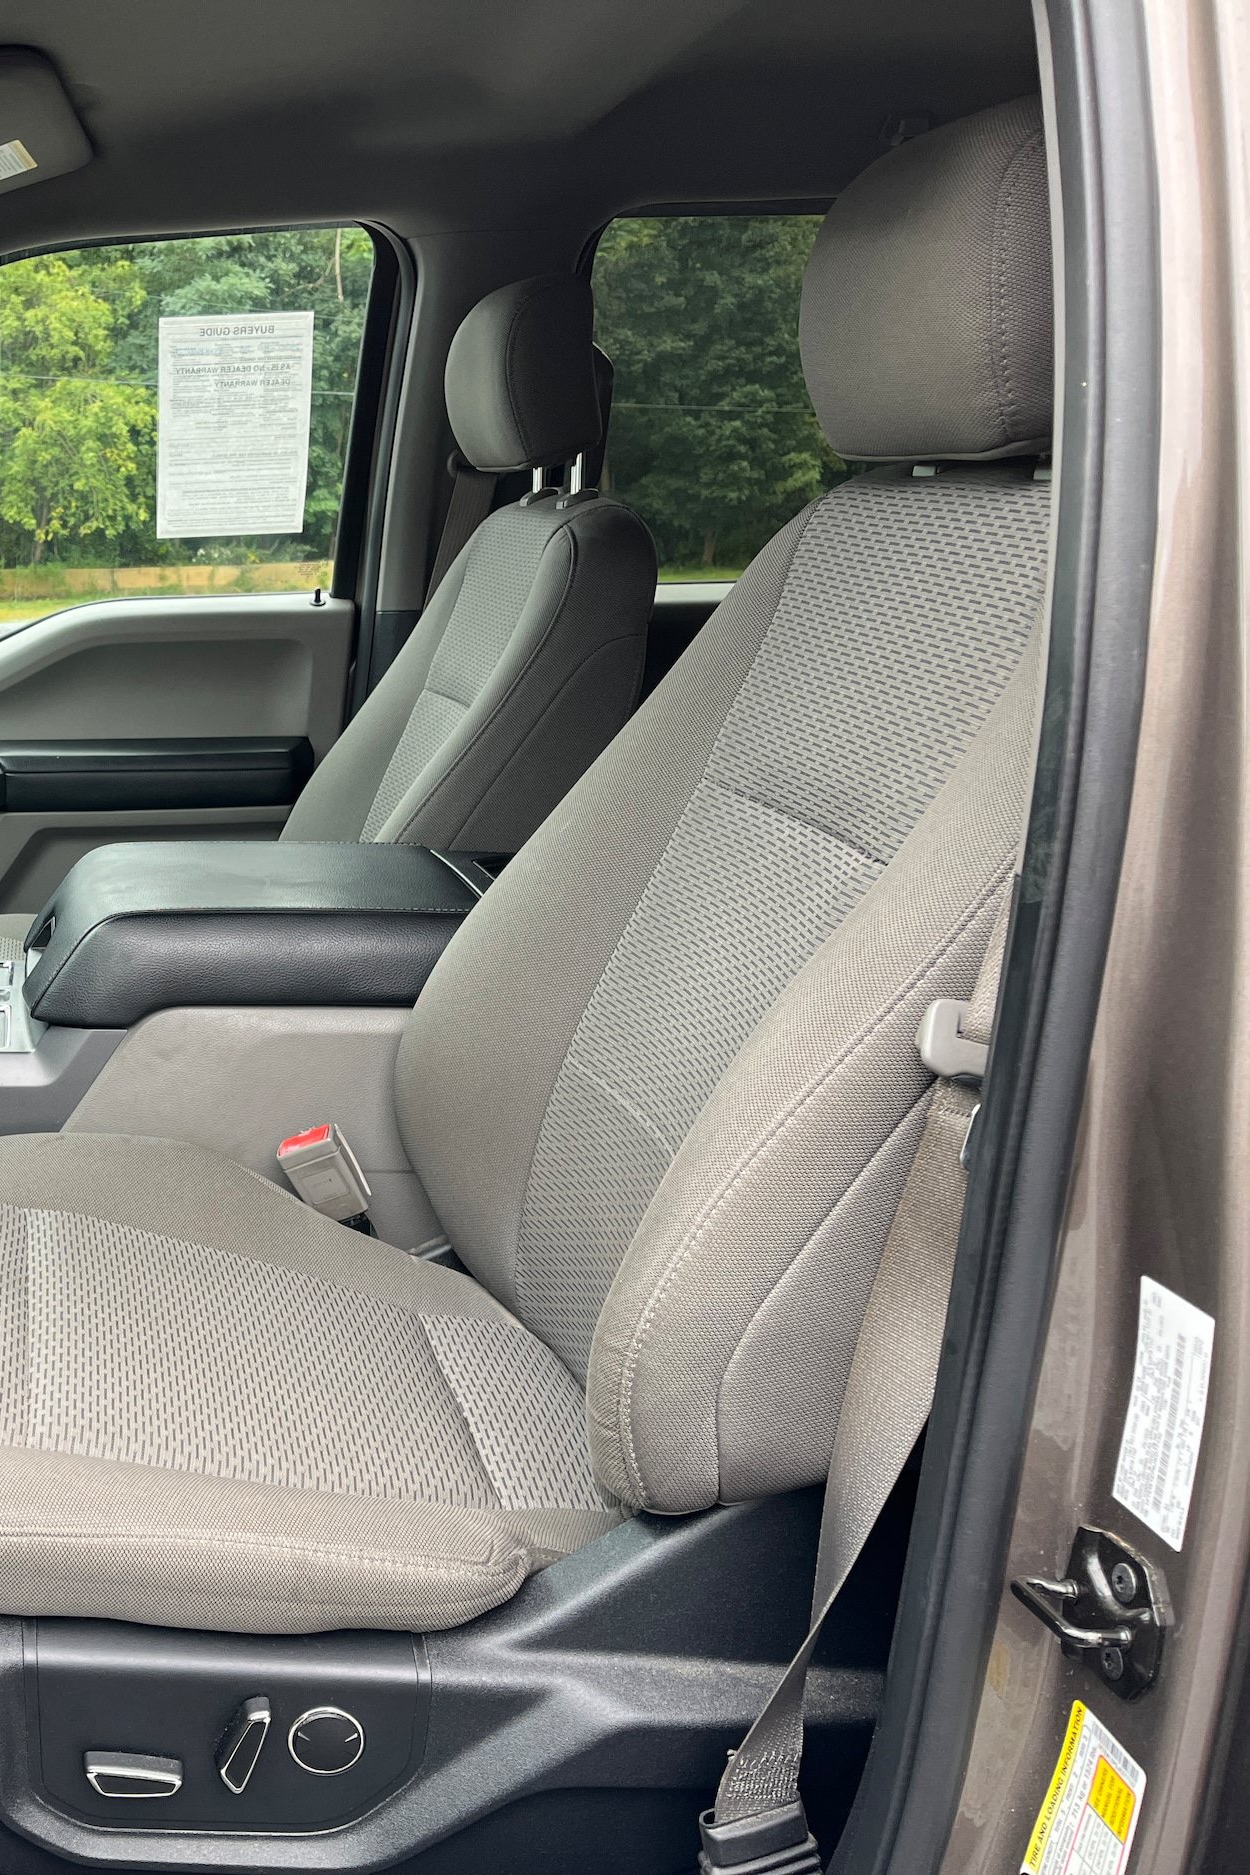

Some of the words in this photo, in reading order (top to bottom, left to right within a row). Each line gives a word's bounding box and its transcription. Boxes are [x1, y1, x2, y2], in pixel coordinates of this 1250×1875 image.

[1029, 1843, 1041, 1867] TIRE
[1038, 1821, 1048, 1845] AND
[1046, 1777, 1064, 1820] LOADING
[1061, 1706, 1082, 1777] INFORMATION
